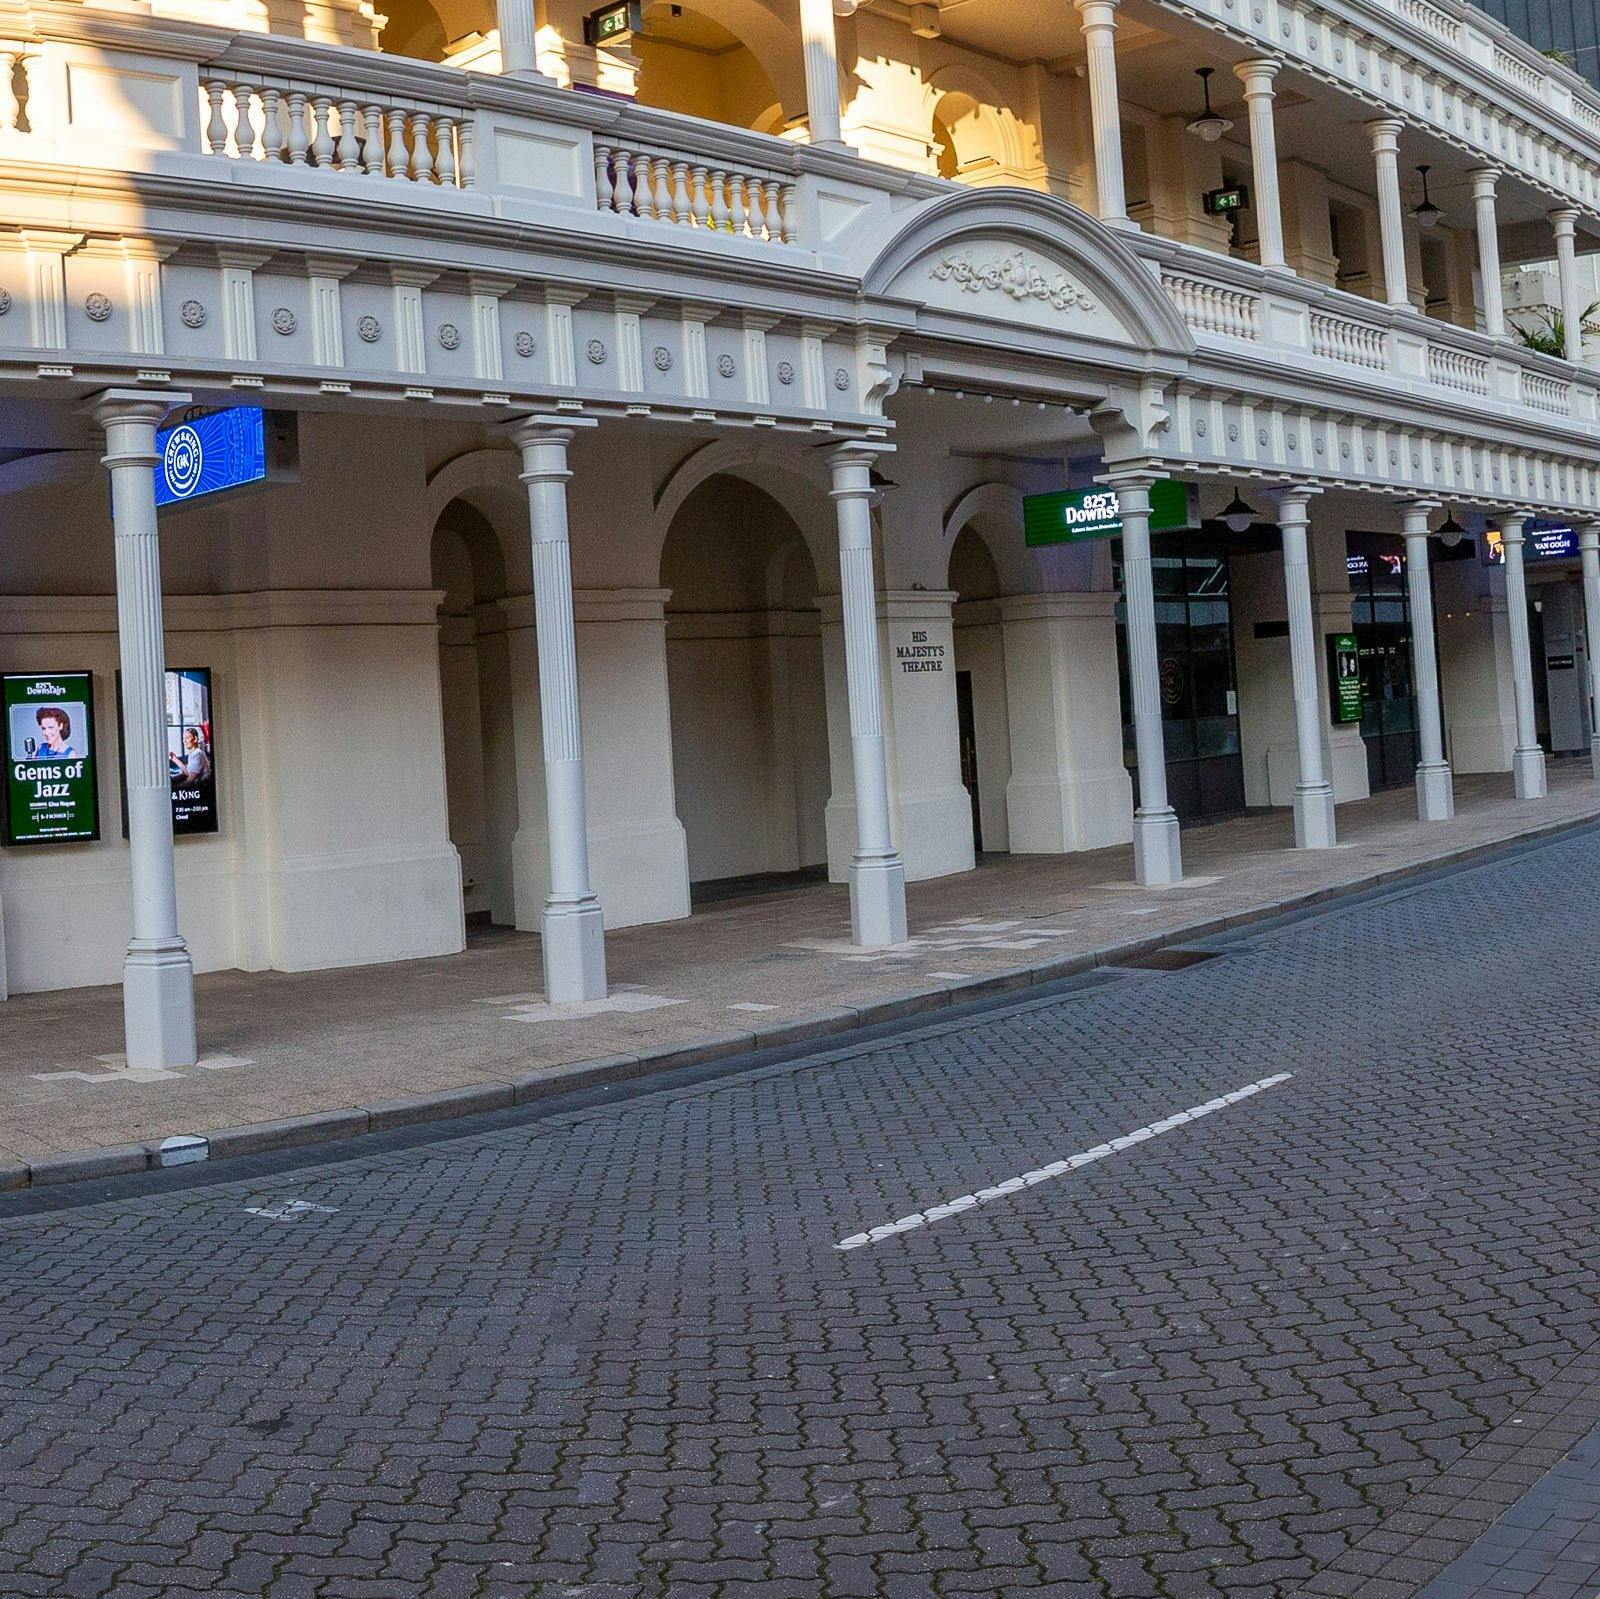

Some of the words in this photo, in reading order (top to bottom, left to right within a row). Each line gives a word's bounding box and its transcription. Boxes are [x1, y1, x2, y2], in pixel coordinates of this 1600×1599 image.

[1083, 494, 1107, 509] 825
[912, 631, 928, 642] HIS
[901, 661, 942, 672] THEATRE
[27, 685, 66, 695] Downstairs
[14, 763, 62, 781] Gems
[65, 761, 84, 779] of
[34, 781, 70, 798] Jazz
